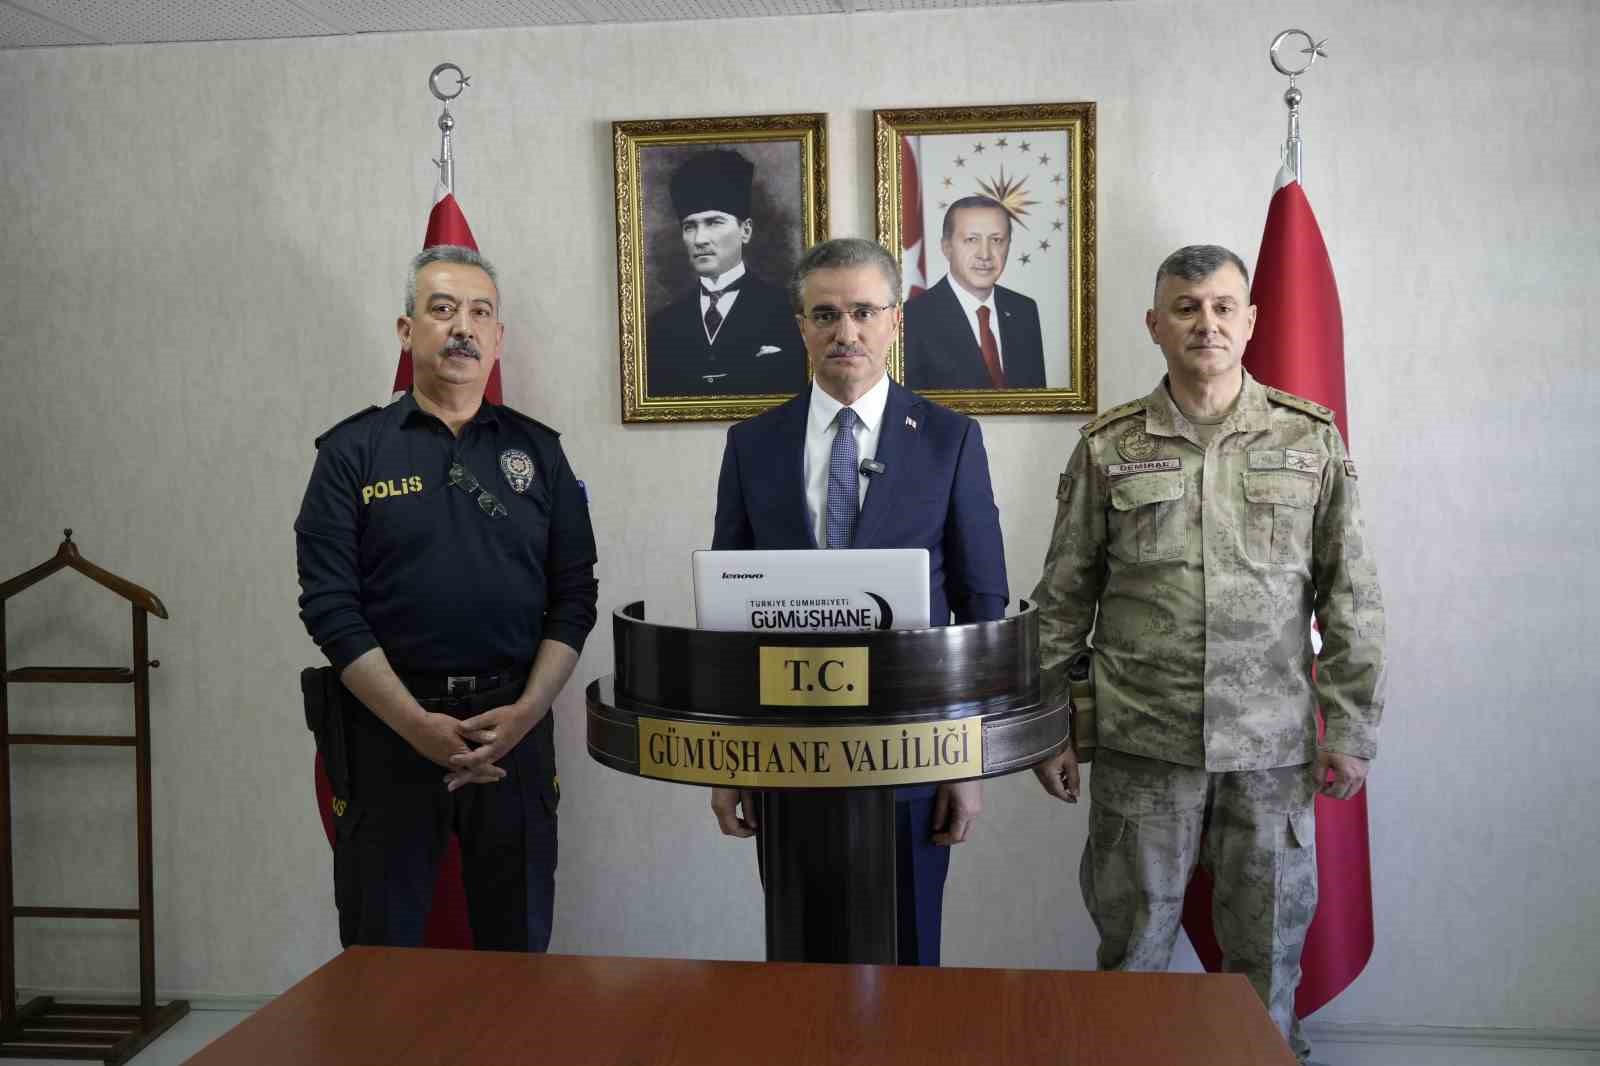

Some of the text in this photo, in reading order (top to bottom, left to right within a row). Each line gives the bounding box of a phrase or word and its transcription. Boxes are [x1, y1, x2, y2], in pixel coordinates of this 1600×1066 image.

[721, 572, 765, 580] lenovo
[751, 608, 871, 631] GÜMÜŞHANE
[784, 659, 854, 692] T.C.
[650, 723, 968, 778] GÜMÜŞHANE VALİLİĞİ
